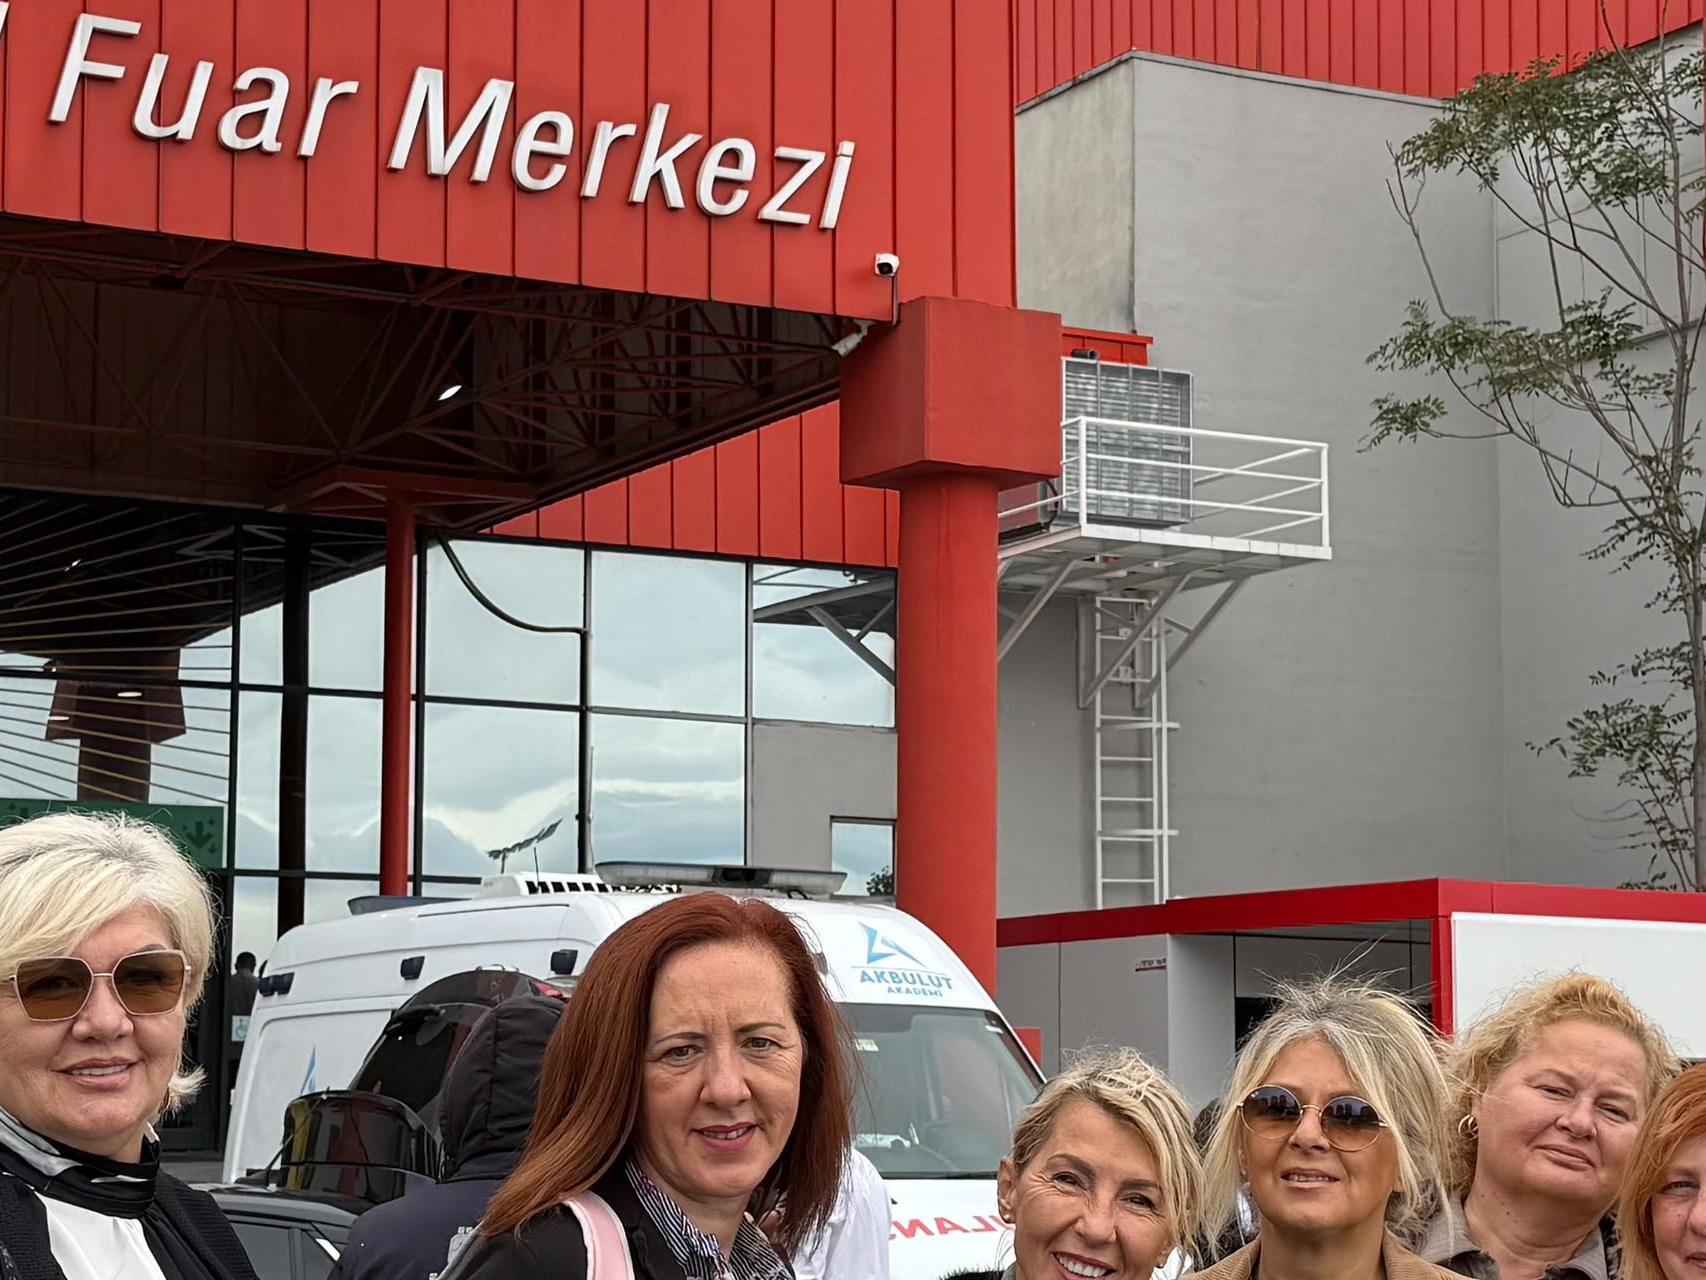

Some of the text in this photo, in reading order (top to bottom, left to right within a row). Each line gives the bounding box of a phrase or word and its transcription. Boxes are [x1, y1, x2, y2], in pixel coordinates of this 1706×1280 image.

[48, 13, 359, 160] Fuar
[387, 66, 855, 231] Merkezi
[860, 970, 953, 989] AKBULUT
